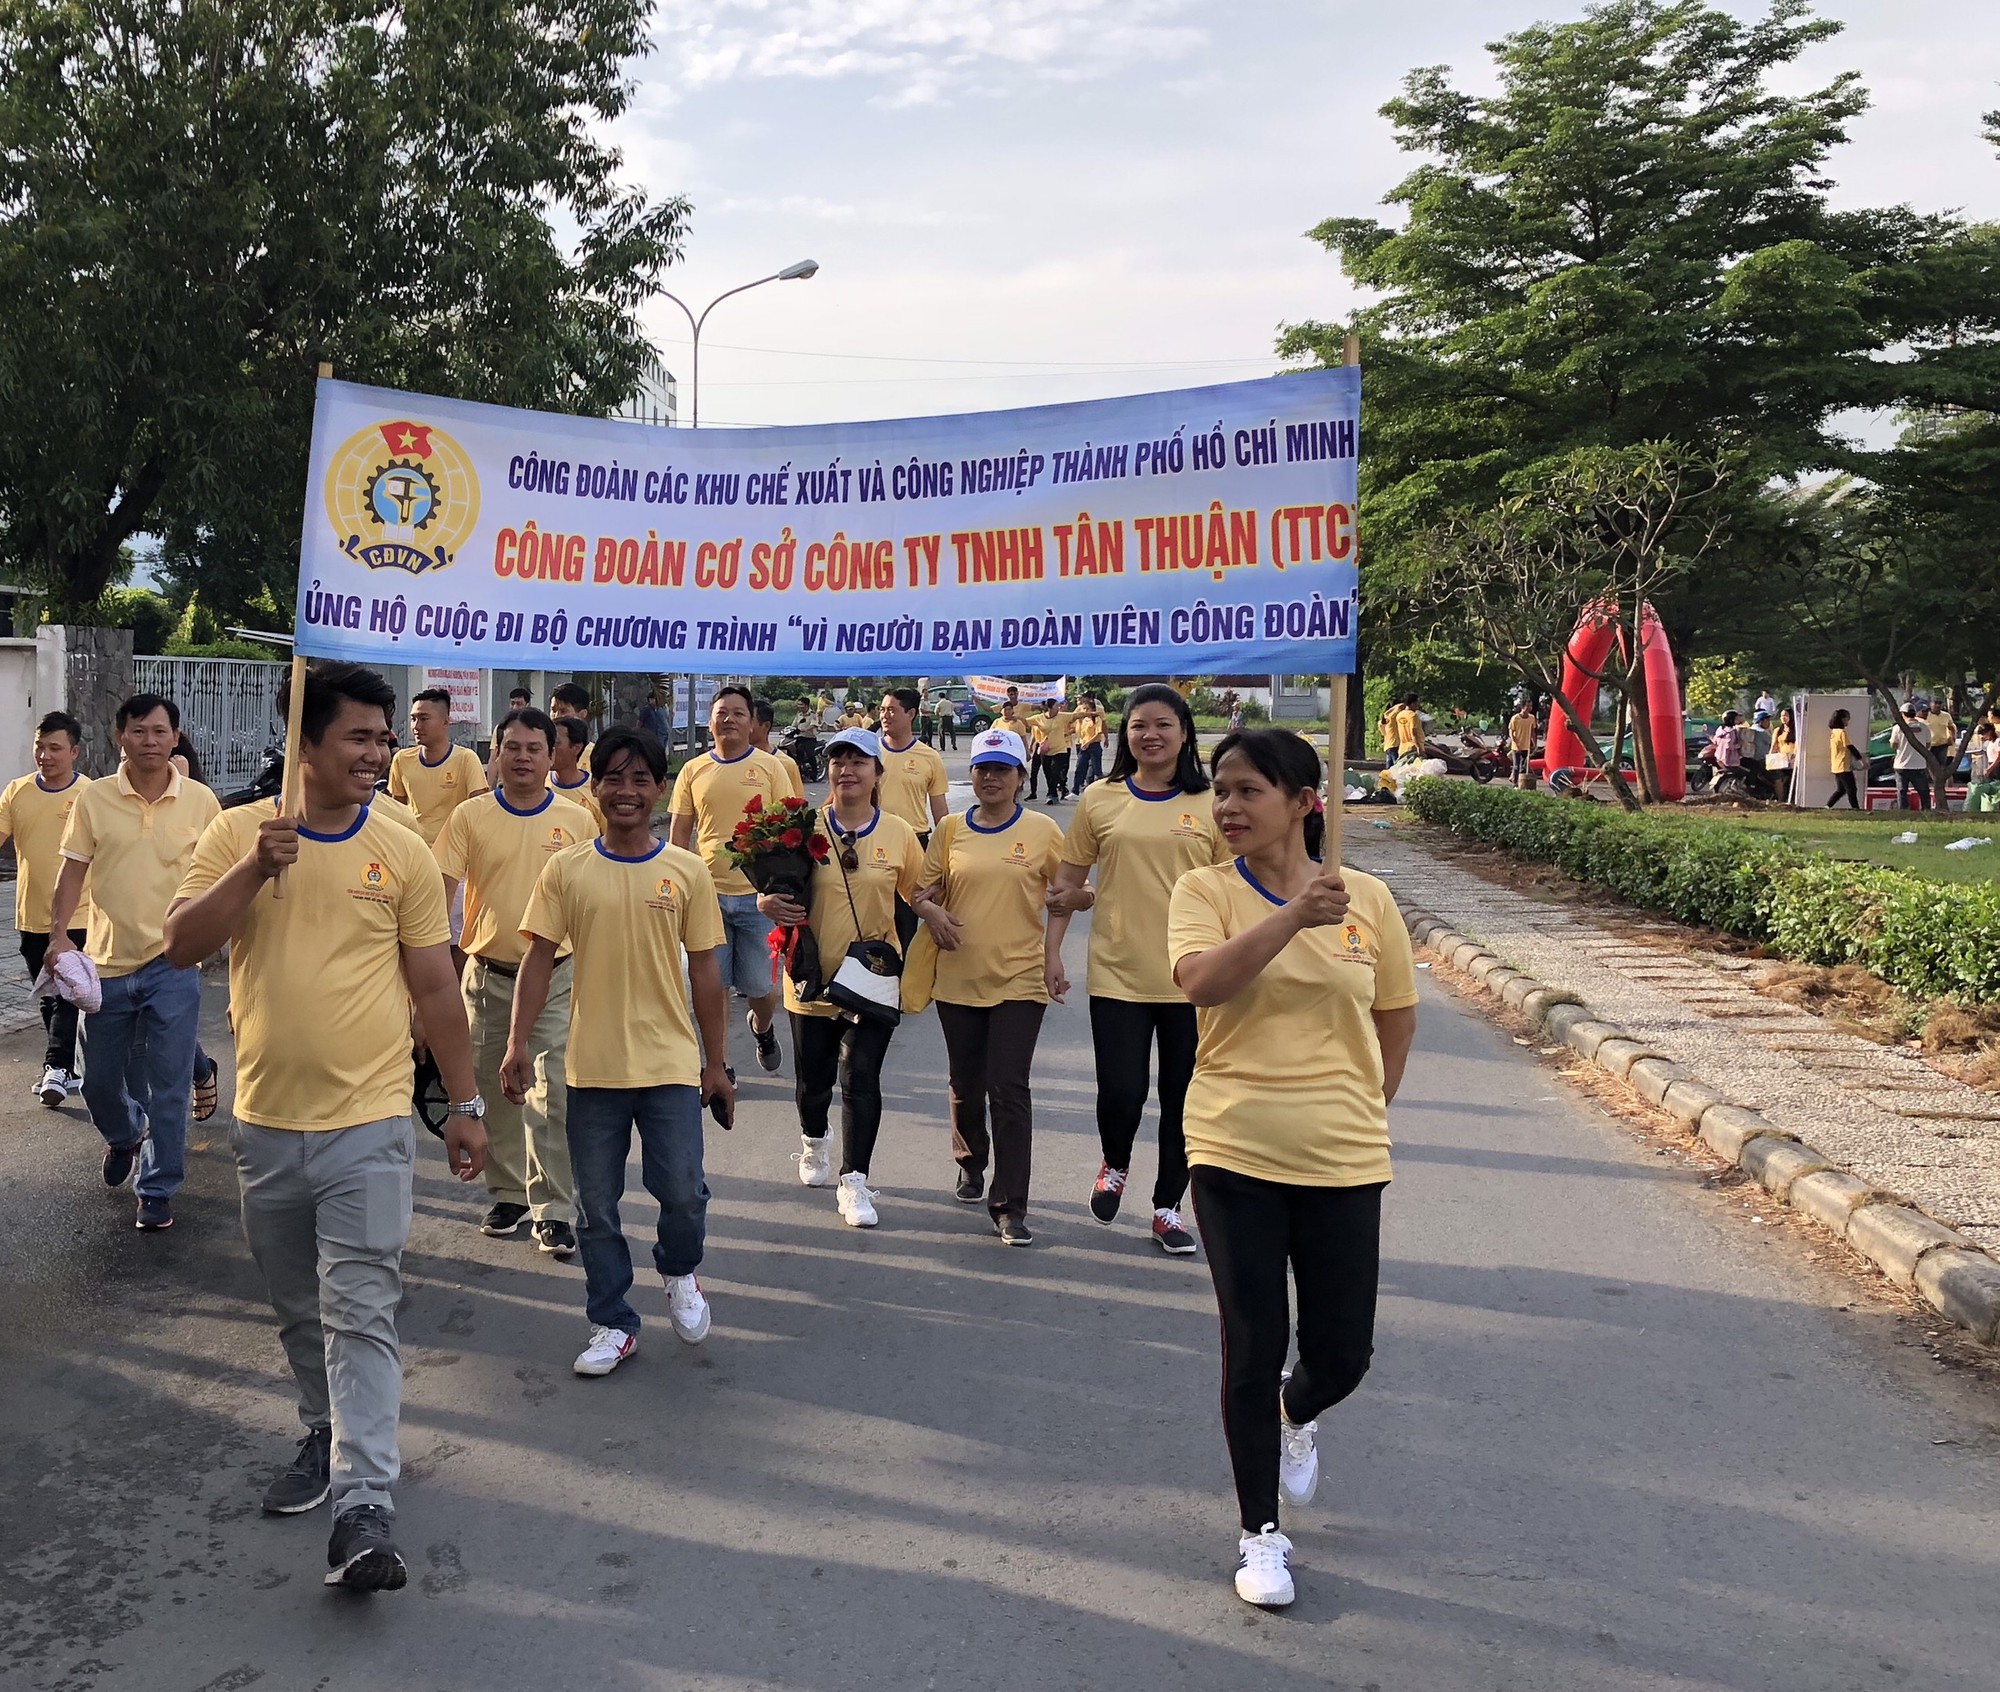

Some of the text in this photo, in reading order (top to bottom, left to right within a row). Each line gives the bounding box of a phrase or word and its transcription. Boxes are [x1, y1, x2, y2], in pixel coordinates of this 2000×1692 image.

[508, 418, 1355, 506] CÔNG ĐOÀN CÁC KHU CHẾ XUẤT VÀ CÔNG NGHIỆP THÀNH PHỐ HỒ CHÍ MINH
[368, 547, 423, 572] CĐVN
[494, 520, 586, 582] CÔNG
[593, 530, 687, 586] ĐOÀN
[695, 537, 743, 589] CƠ
[748, 527, 798, 591] SỞ
[804, 533, 894, 591] CÔNG
[903, 535, 941, 587] TY
[951, 528, 1044, 584] TNHH
[1054, 512, 1125, 577] TÂN
[1134, 500, 1258, 580] THUẬN
[304, 579, 362, 629] ỦNG
[369, 594, 407, 641] HỘ
[415, 601, 488, 646] CUỘC
[495, 611, 524, 642] ĐI
[530, 608, 568, 651] BỘ
[575, 615, 688, 650] CHƯƠNG
[696, 615, 778, 652] TRÌNH
[835, 614, 923, 653] NGƯỜI
[931, 619, 992, 657] BẠN
[1000, 608, 1082, 649] ĐOÀN
[1091, 604, 1160, 646] VIÊN
[1170, 600, 1254, 644] CÔNG
